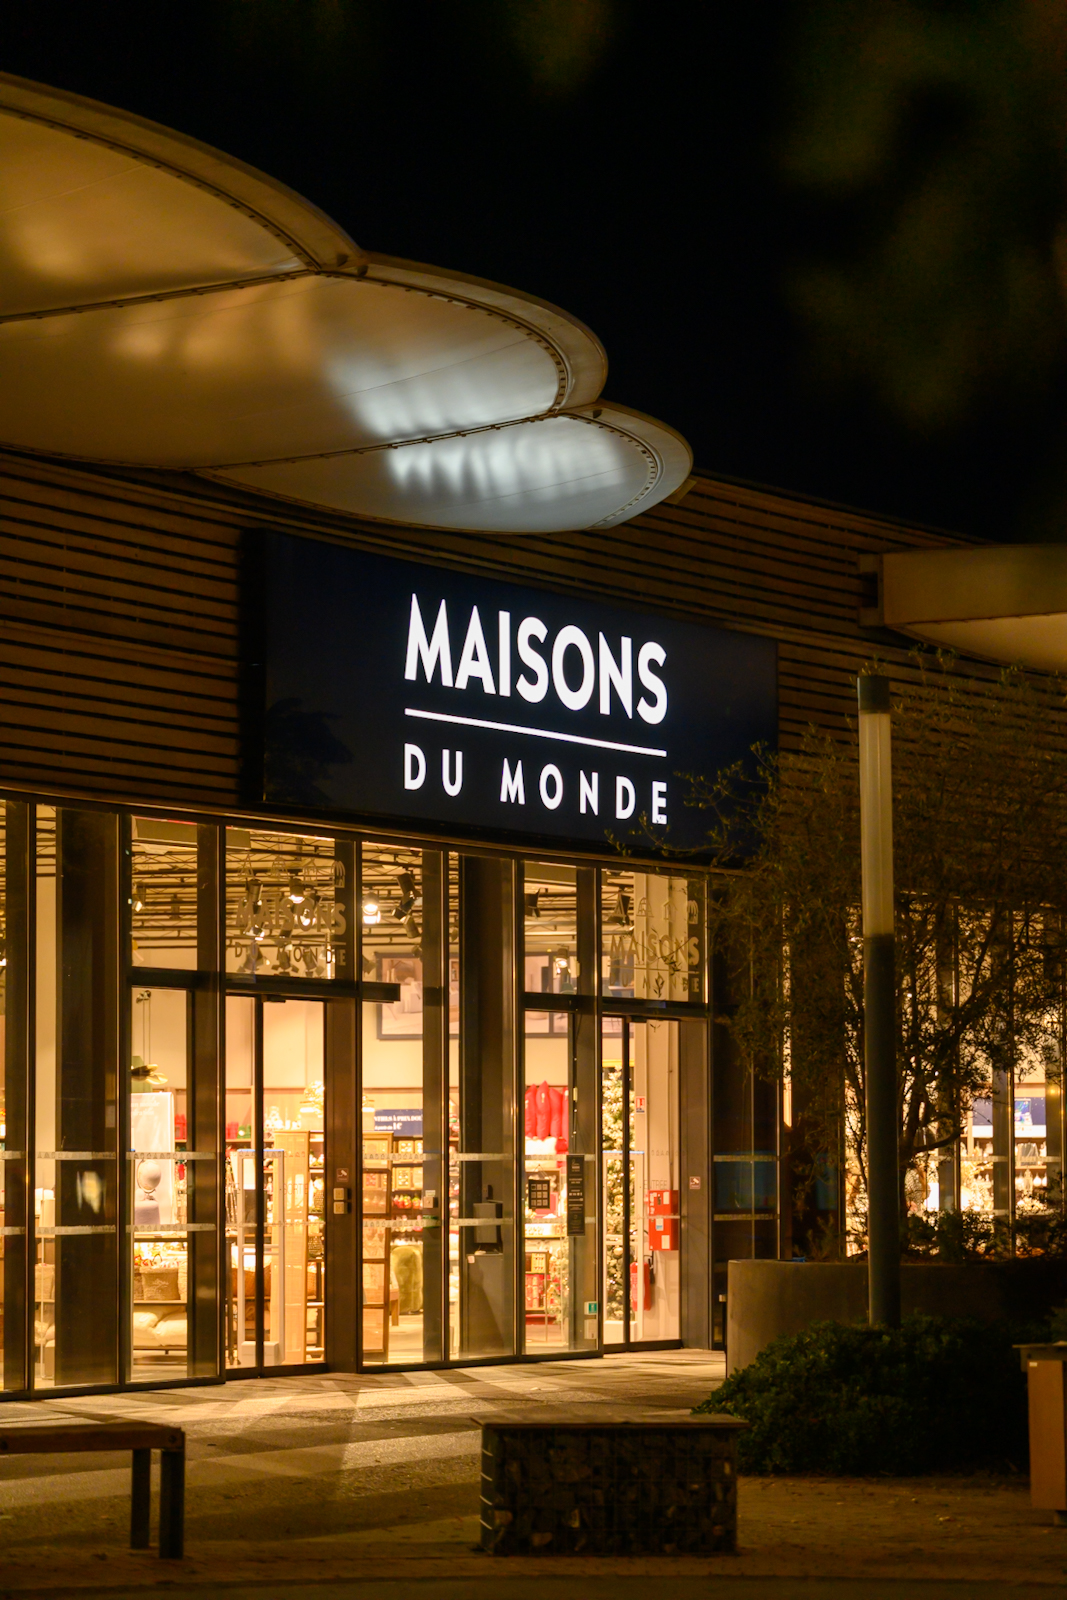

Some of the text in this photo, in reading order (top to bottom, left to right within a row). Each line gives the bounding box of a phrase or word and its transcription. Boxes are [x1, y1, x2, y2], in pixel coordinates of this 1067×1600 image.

[404, 592, 668, 725] MAISONS
[404, 742, 667, 825] DU MONDE
[235, 895, 347, 936] MAISONS
[609, 931, 700, 966] MAISONS
[283, 1182, 308, 1195] SORTE
